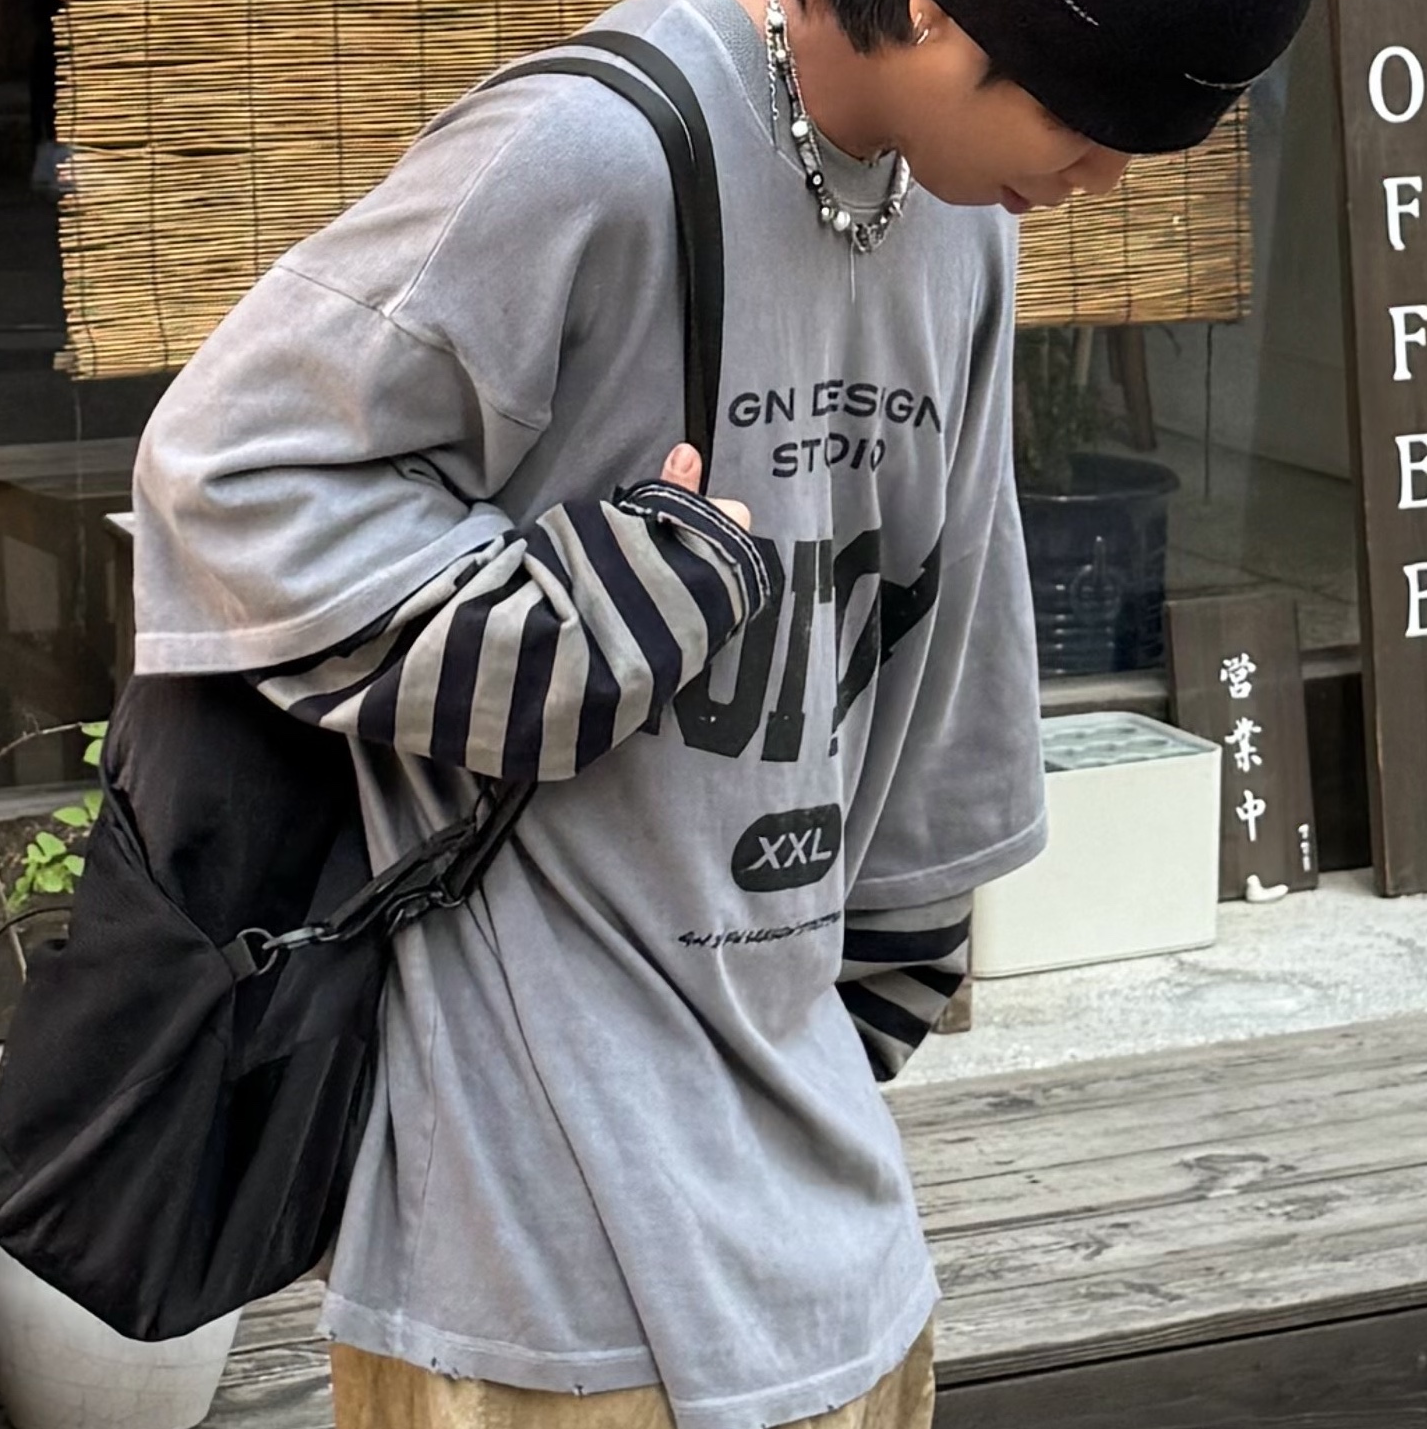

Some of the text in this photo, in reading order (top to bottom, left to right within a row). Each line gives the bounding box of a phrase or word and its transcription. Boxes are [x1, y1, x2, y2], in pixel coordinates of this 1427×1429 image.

[1220, 652, 1267, 842] 営業中
[747, 827, 832, 870] XXL
